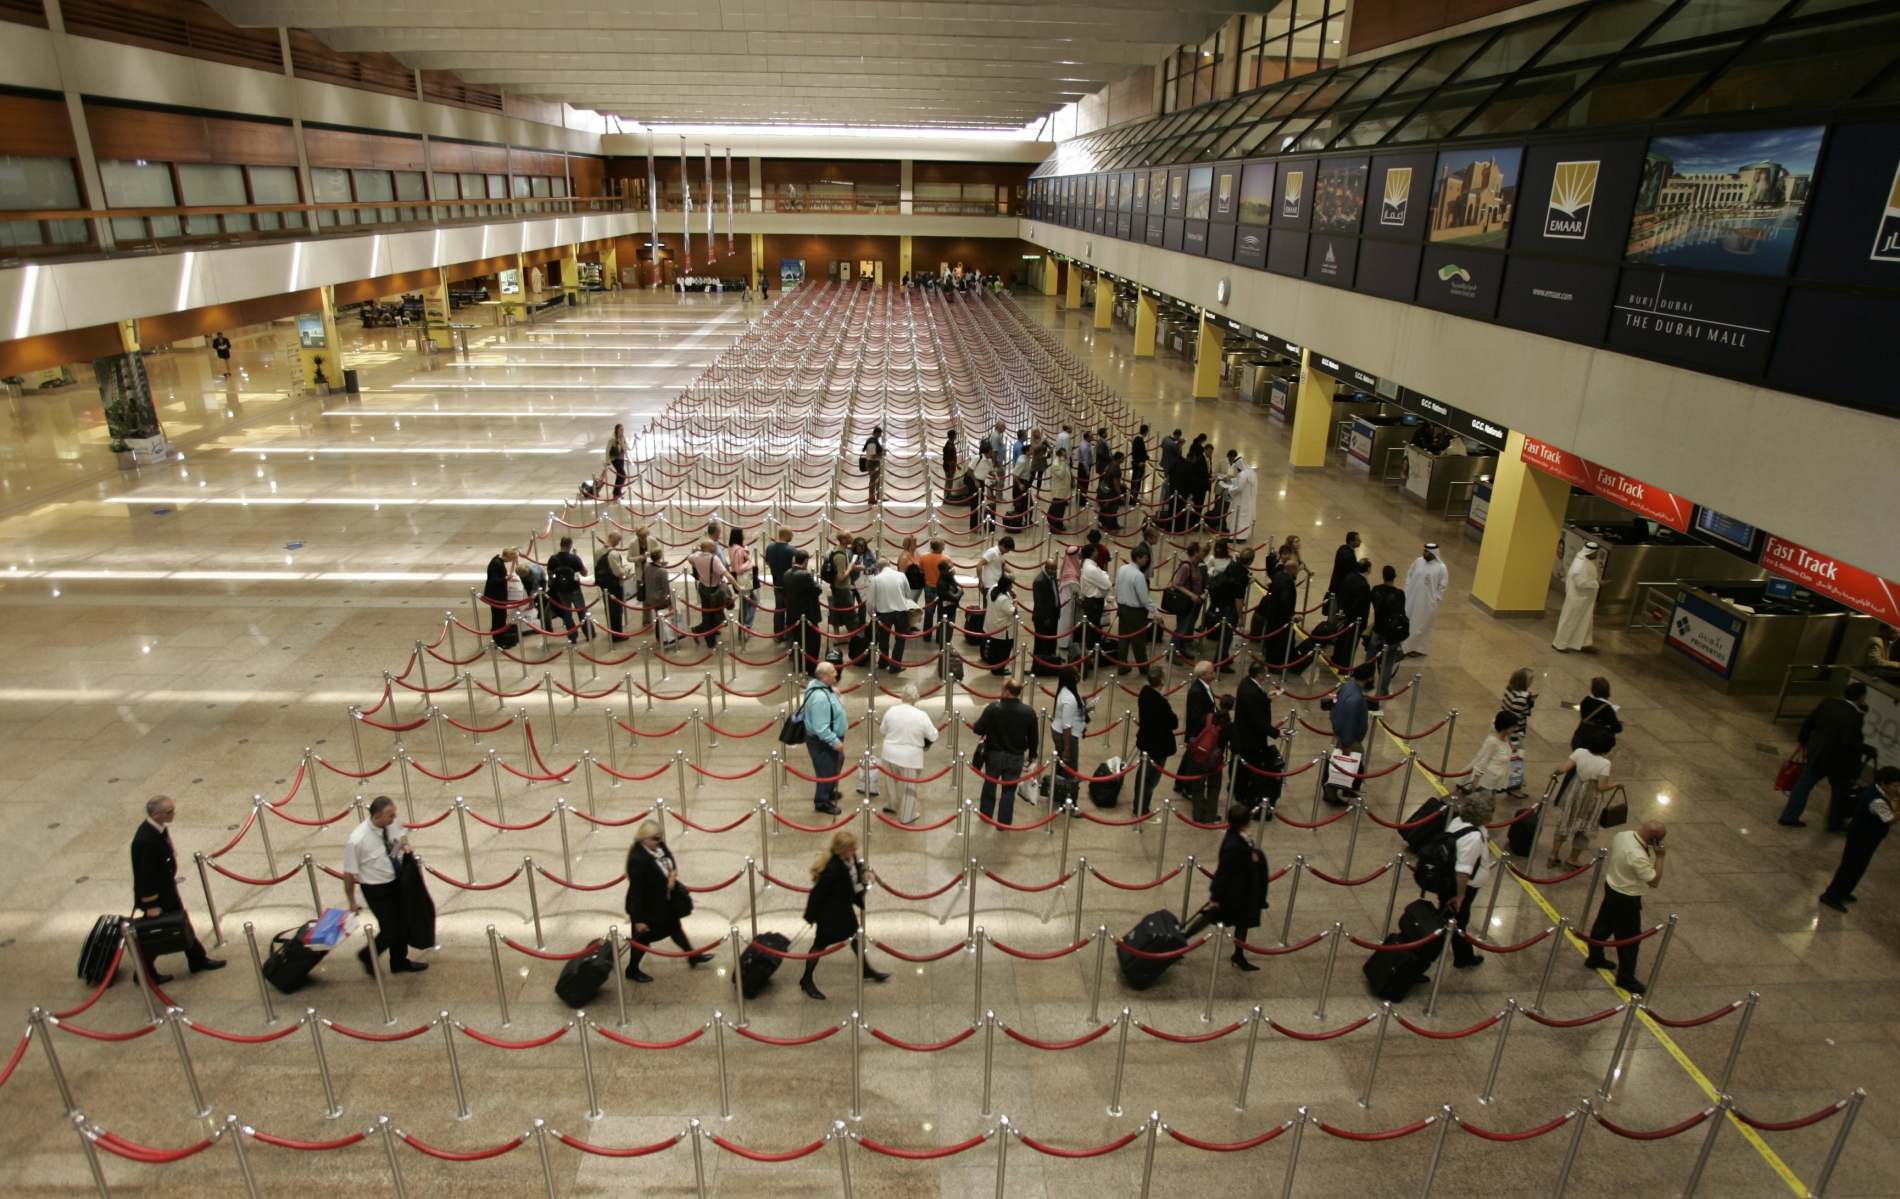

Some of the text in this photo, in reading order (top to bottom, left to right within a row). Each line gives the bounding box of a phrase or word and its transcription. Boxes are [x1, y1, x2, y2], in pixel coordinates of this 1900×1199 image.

[1550, 220, 1582, 233] EMAAR
[1533, 288, 1573, 301] www.emaar.com
[1629, 294, 1693, 312] BURJ DUBAI
[1626, 313, 1746, 348] THE DUBAI MALL
[1484, 425, 1503, 438] Nationals
[1524, 438, 1561, 465] Fast Track
[1597, 469, 1616, 487] Fast
[1618, 476, 1644, 500] Track
[1766, 537, 1838, 580] Fast Track
[1779, 562, 1799, 577] Business
[1799, 571, 1813, 582] Class
[1691, 637, 1725, 661] PROPERTIES
[1698, 632, 1722, 650] DUBAI
